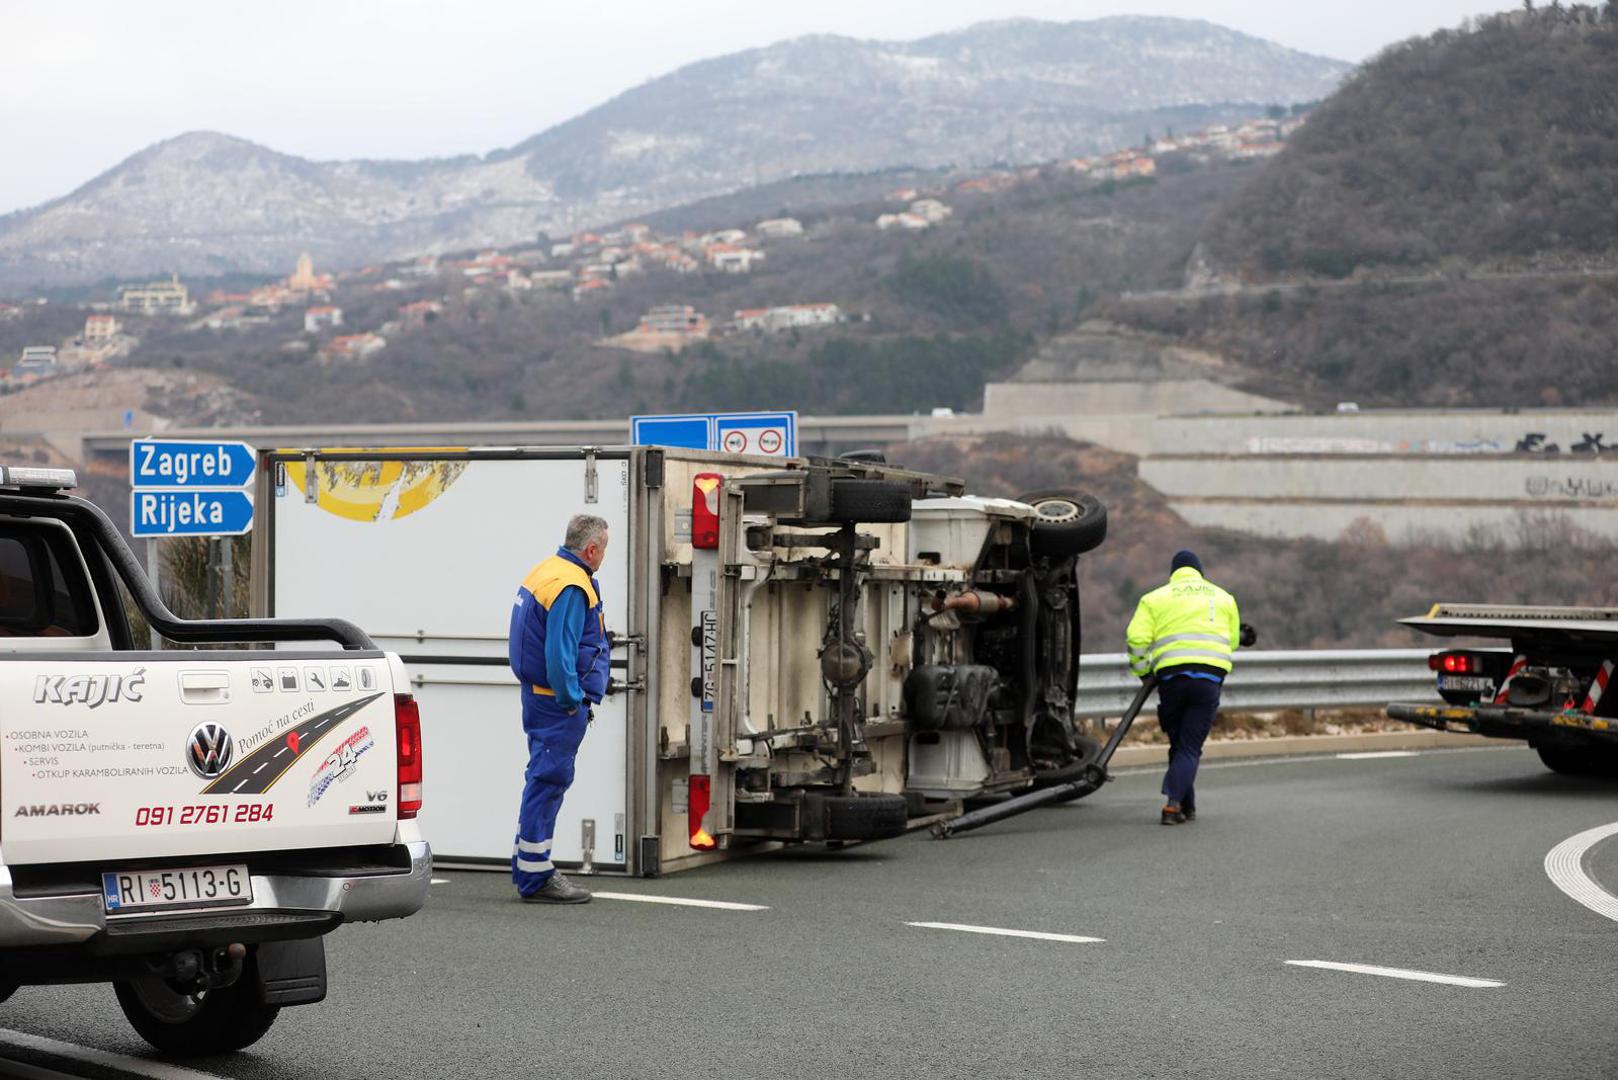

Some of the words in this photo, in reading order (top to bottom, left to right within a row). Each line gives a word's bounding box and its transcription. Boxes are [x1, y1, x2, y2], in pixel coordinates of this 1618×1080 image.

[140, 445, 231, 484] Zagreb
[142, 493, 223, 532] Rijeka
[33, 667, 146, 709] KAJIĆ
[10, 731, 52, 740] OSOBNA
[54, 730, 88, 739] VOZILA
[238, 720, 274, 754] Pomoć
[276, 714, 290, 729] na
[291, 698, 315, 720] cesti
[18, 744, 50, 753] KOMBI
[52, 743, 87, 752] VOZILA
[133, 742, 165, 752] teretna)
[28, 757, 59, 766] SERVIS
[326, 743, 358, 779] 24
[37, 769, 70, 779] OTKUP
[72, 767, 153, 777] KARAMBOLIRANIH
[155, 766, 189, 775] VOZILA
[366, 790, 388, 802] V6
[15, 803, 101, 817] AMAROK
[136, 807, 174, 826] 091
[180, 805, 228, 825] 2761
[234, 804, 274, 823] 284
[120, 875, 144, 903] RI
[161, 868, 241, 901] 5113-G
